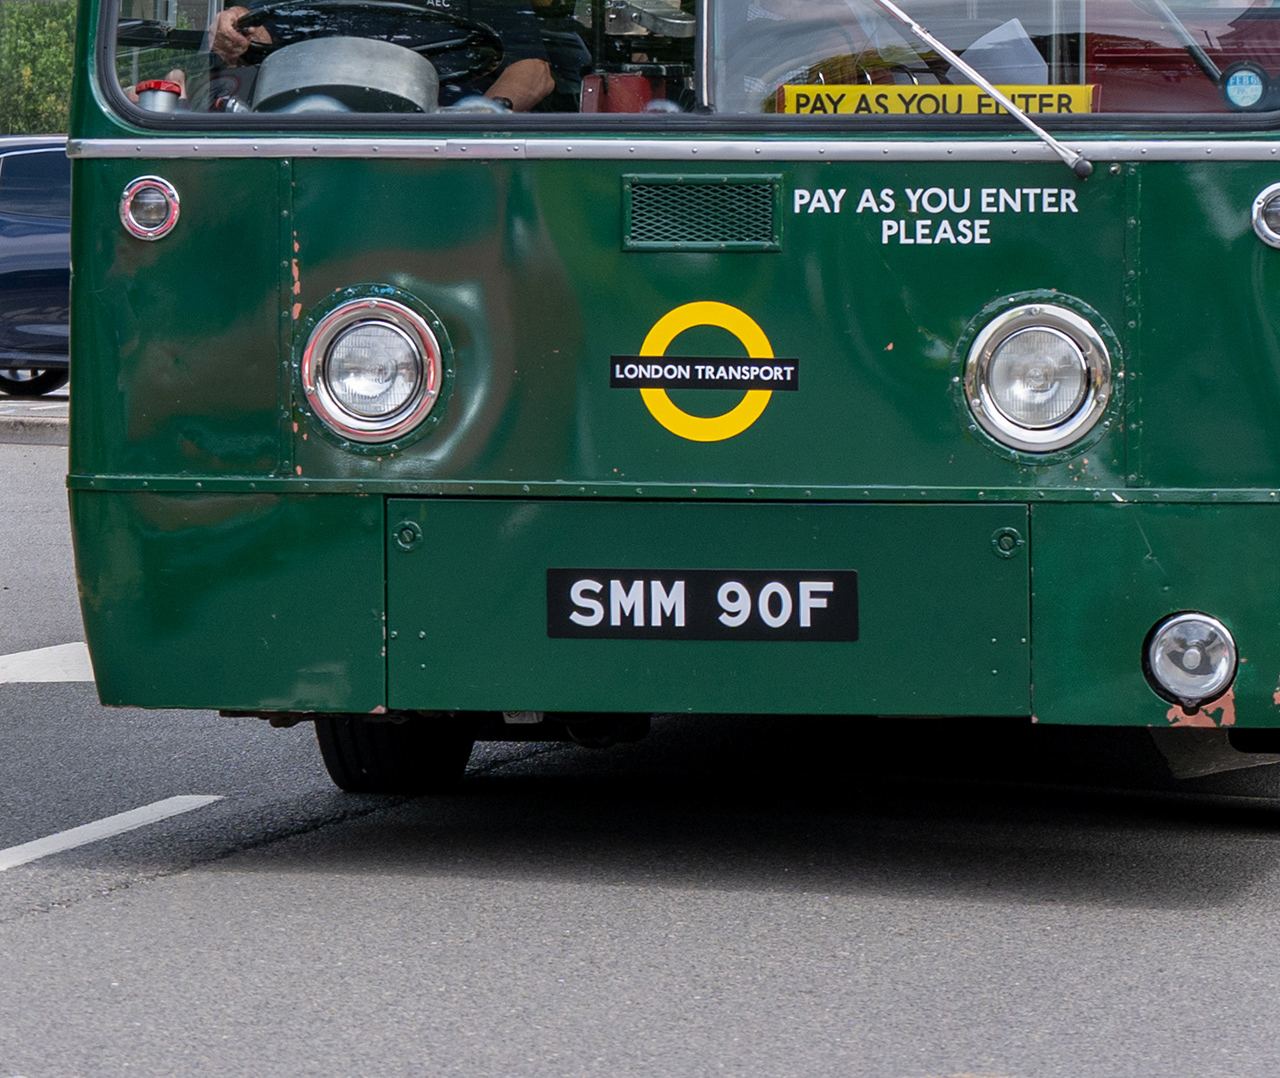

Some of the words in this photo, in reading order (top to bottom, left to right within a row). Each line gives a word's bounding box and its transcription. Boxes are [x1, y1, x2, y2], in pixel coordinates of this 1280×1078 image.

[1229, 76, 1249, 85] FEB
[795, 93, 846, 114] PAY
[855, 93, 888, 114] AS
[897, 93, 963, 114] YOU
[793, 188, 846, 213] PAY
[856, 188, 895, 213] AS
[904, 187, 970, 213] YOU
[981, 188, 1079, 213] ENTER
[881, 219, 991, 244] PLEASE
[615, 364, 690, 379] LONDON
[694, 365, 795, 381] TRANSPORT
[569, 579, 686, 627] SMM
[716, 581, 834, 628] 90F
